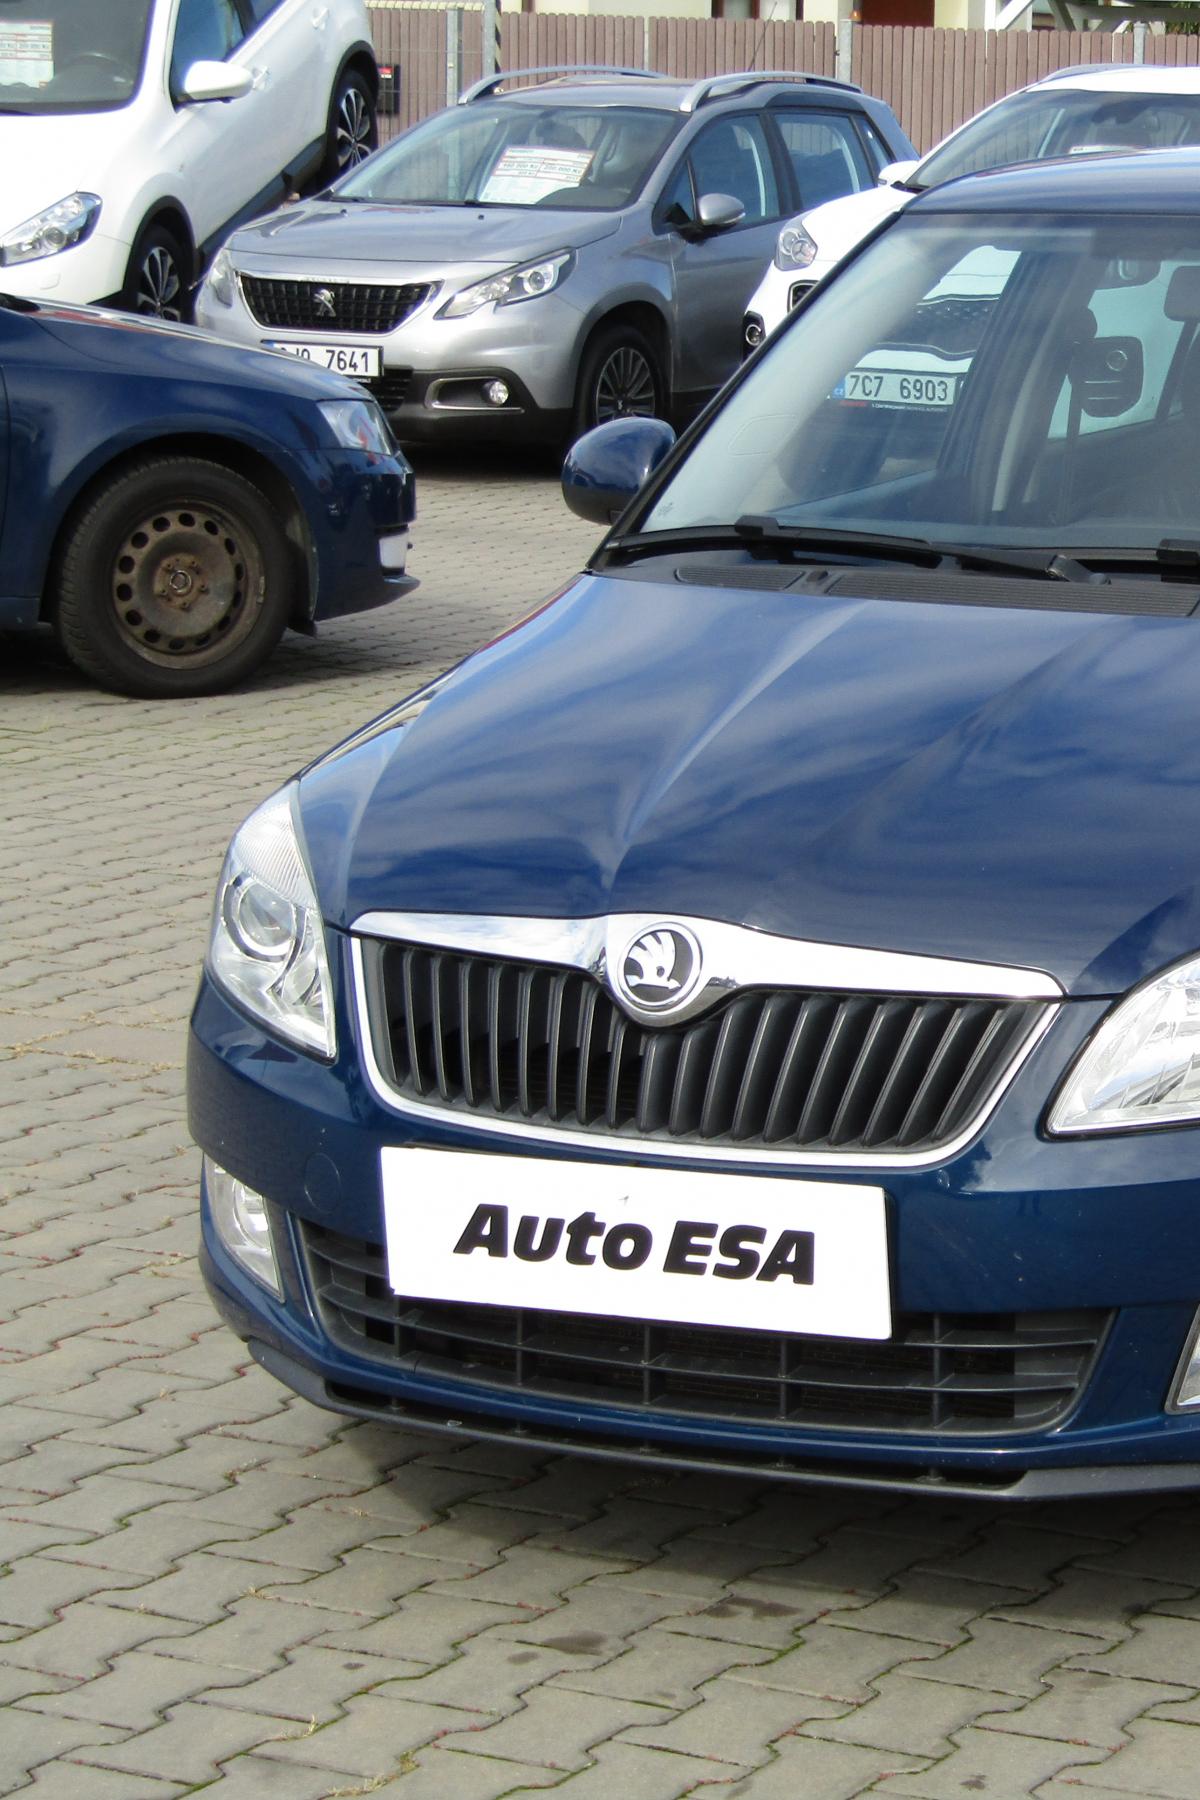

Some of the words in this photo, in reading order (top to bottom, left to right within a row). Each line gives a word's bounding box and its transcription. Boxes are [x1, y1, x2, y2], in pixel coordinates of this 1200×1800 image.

[325, 348, 369, 373] 7641
[848, 374, 884, 398] 7C7
[899, 377, 948, 402] 6903
[453, 1203, 653, 1271] Auto
[662, 1220, 815, 1285] ESA
